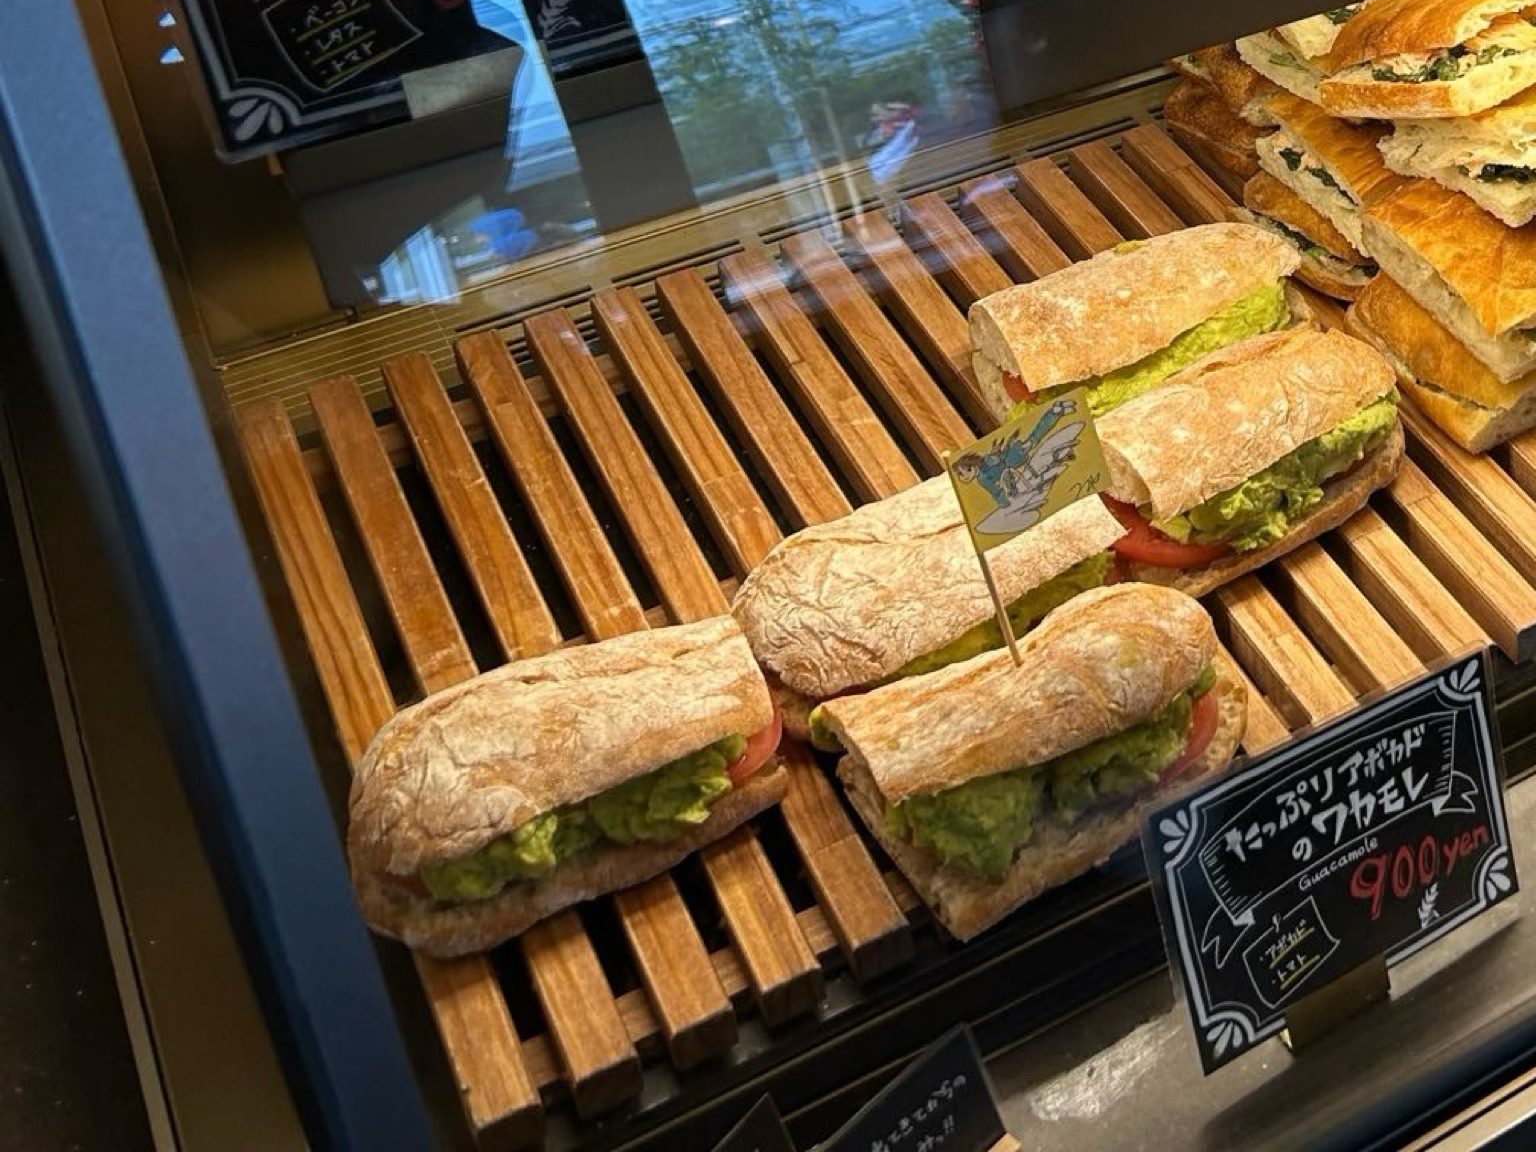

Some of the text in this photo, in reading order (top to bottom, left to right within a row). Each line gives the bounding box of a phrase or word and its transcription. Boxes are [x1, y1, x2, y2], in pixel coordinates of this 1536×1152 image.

[317, 21, 364, 50] レタス
[331, 39, 376, 73] トマト
[1224, 723, 1427, 862] たっぷりアボカド
[1299, 837, 1379, 892] Guacamole
[1265, 918, 1307, 960] アボカド
[1276, 953, 1307, 982] トマト
